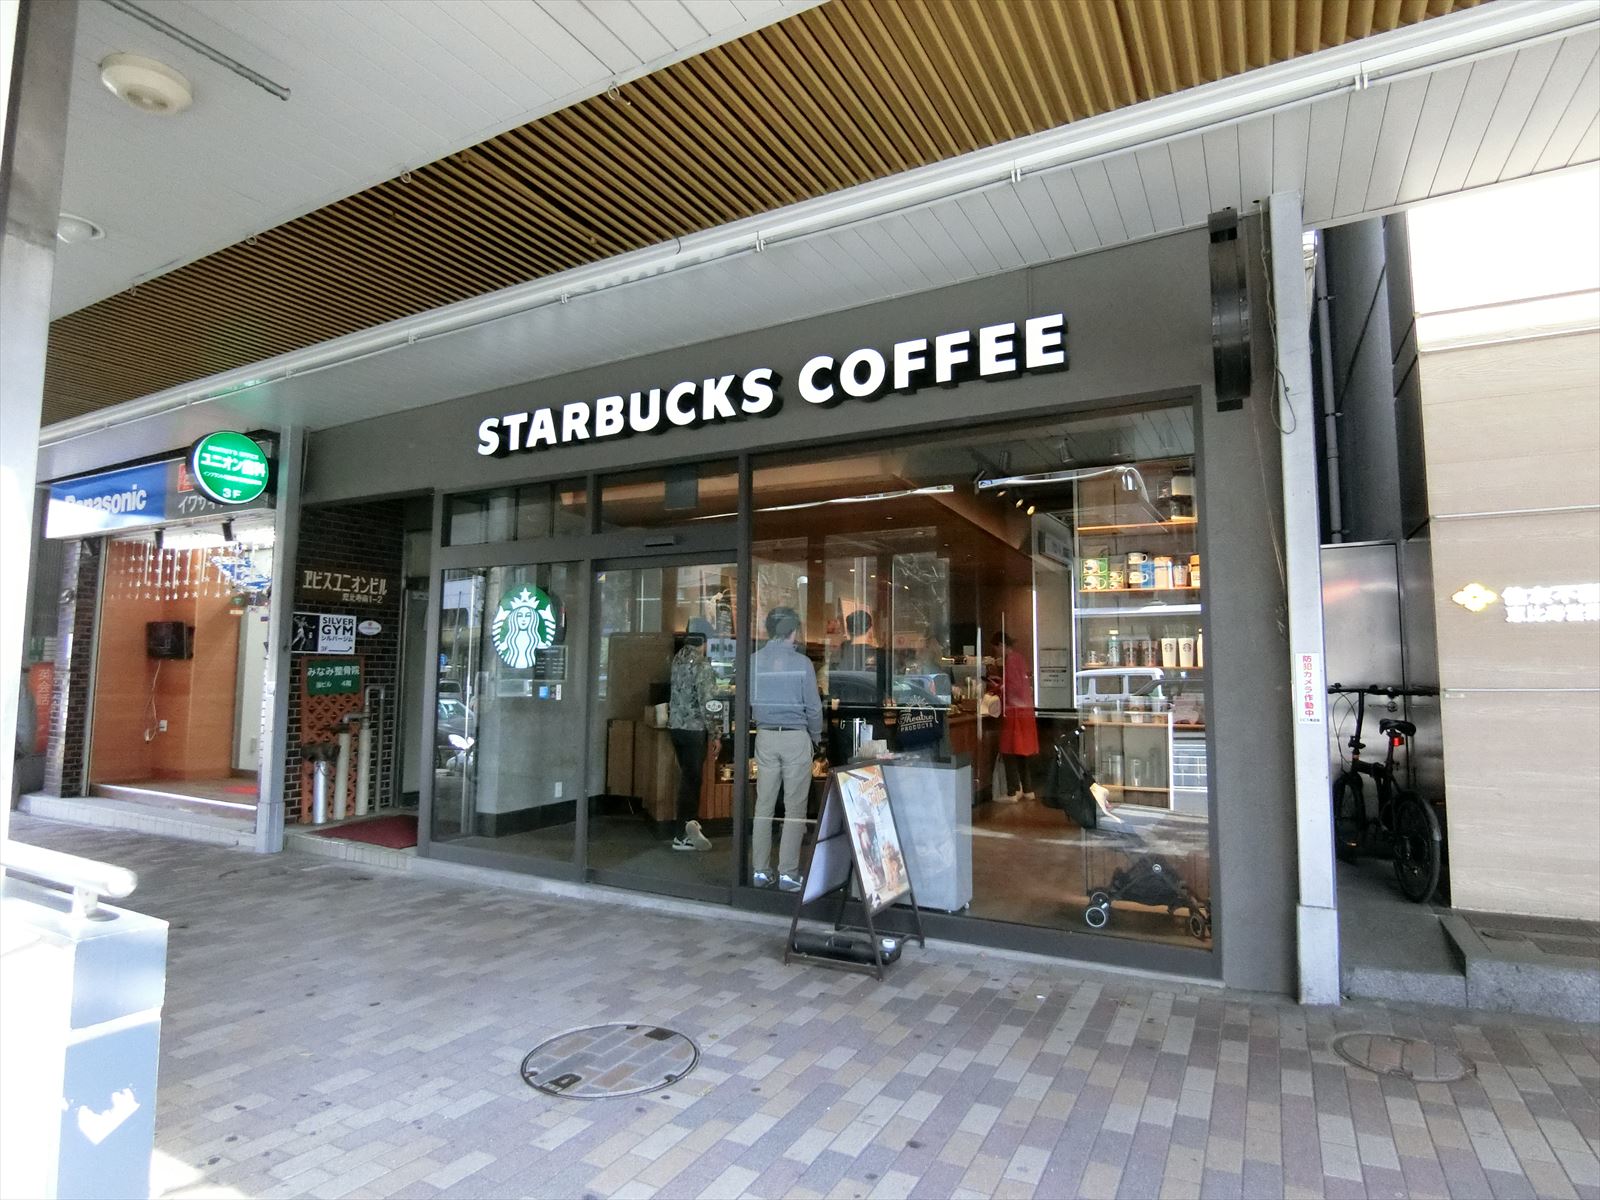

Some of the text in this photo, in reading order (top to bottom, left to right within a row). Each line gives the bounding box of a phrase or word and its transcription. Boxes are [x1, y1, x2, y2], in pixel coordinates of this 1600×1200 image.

[477, 313, 1066, 456] STARBUCKS COFFEE
[222, 487, 242, 499] 3F
[322, 616, 354, 626] SILVER
[321, 624, 354, 636] GYM
[1302, 655, 1315, 717] 防犯カメラ作動中
